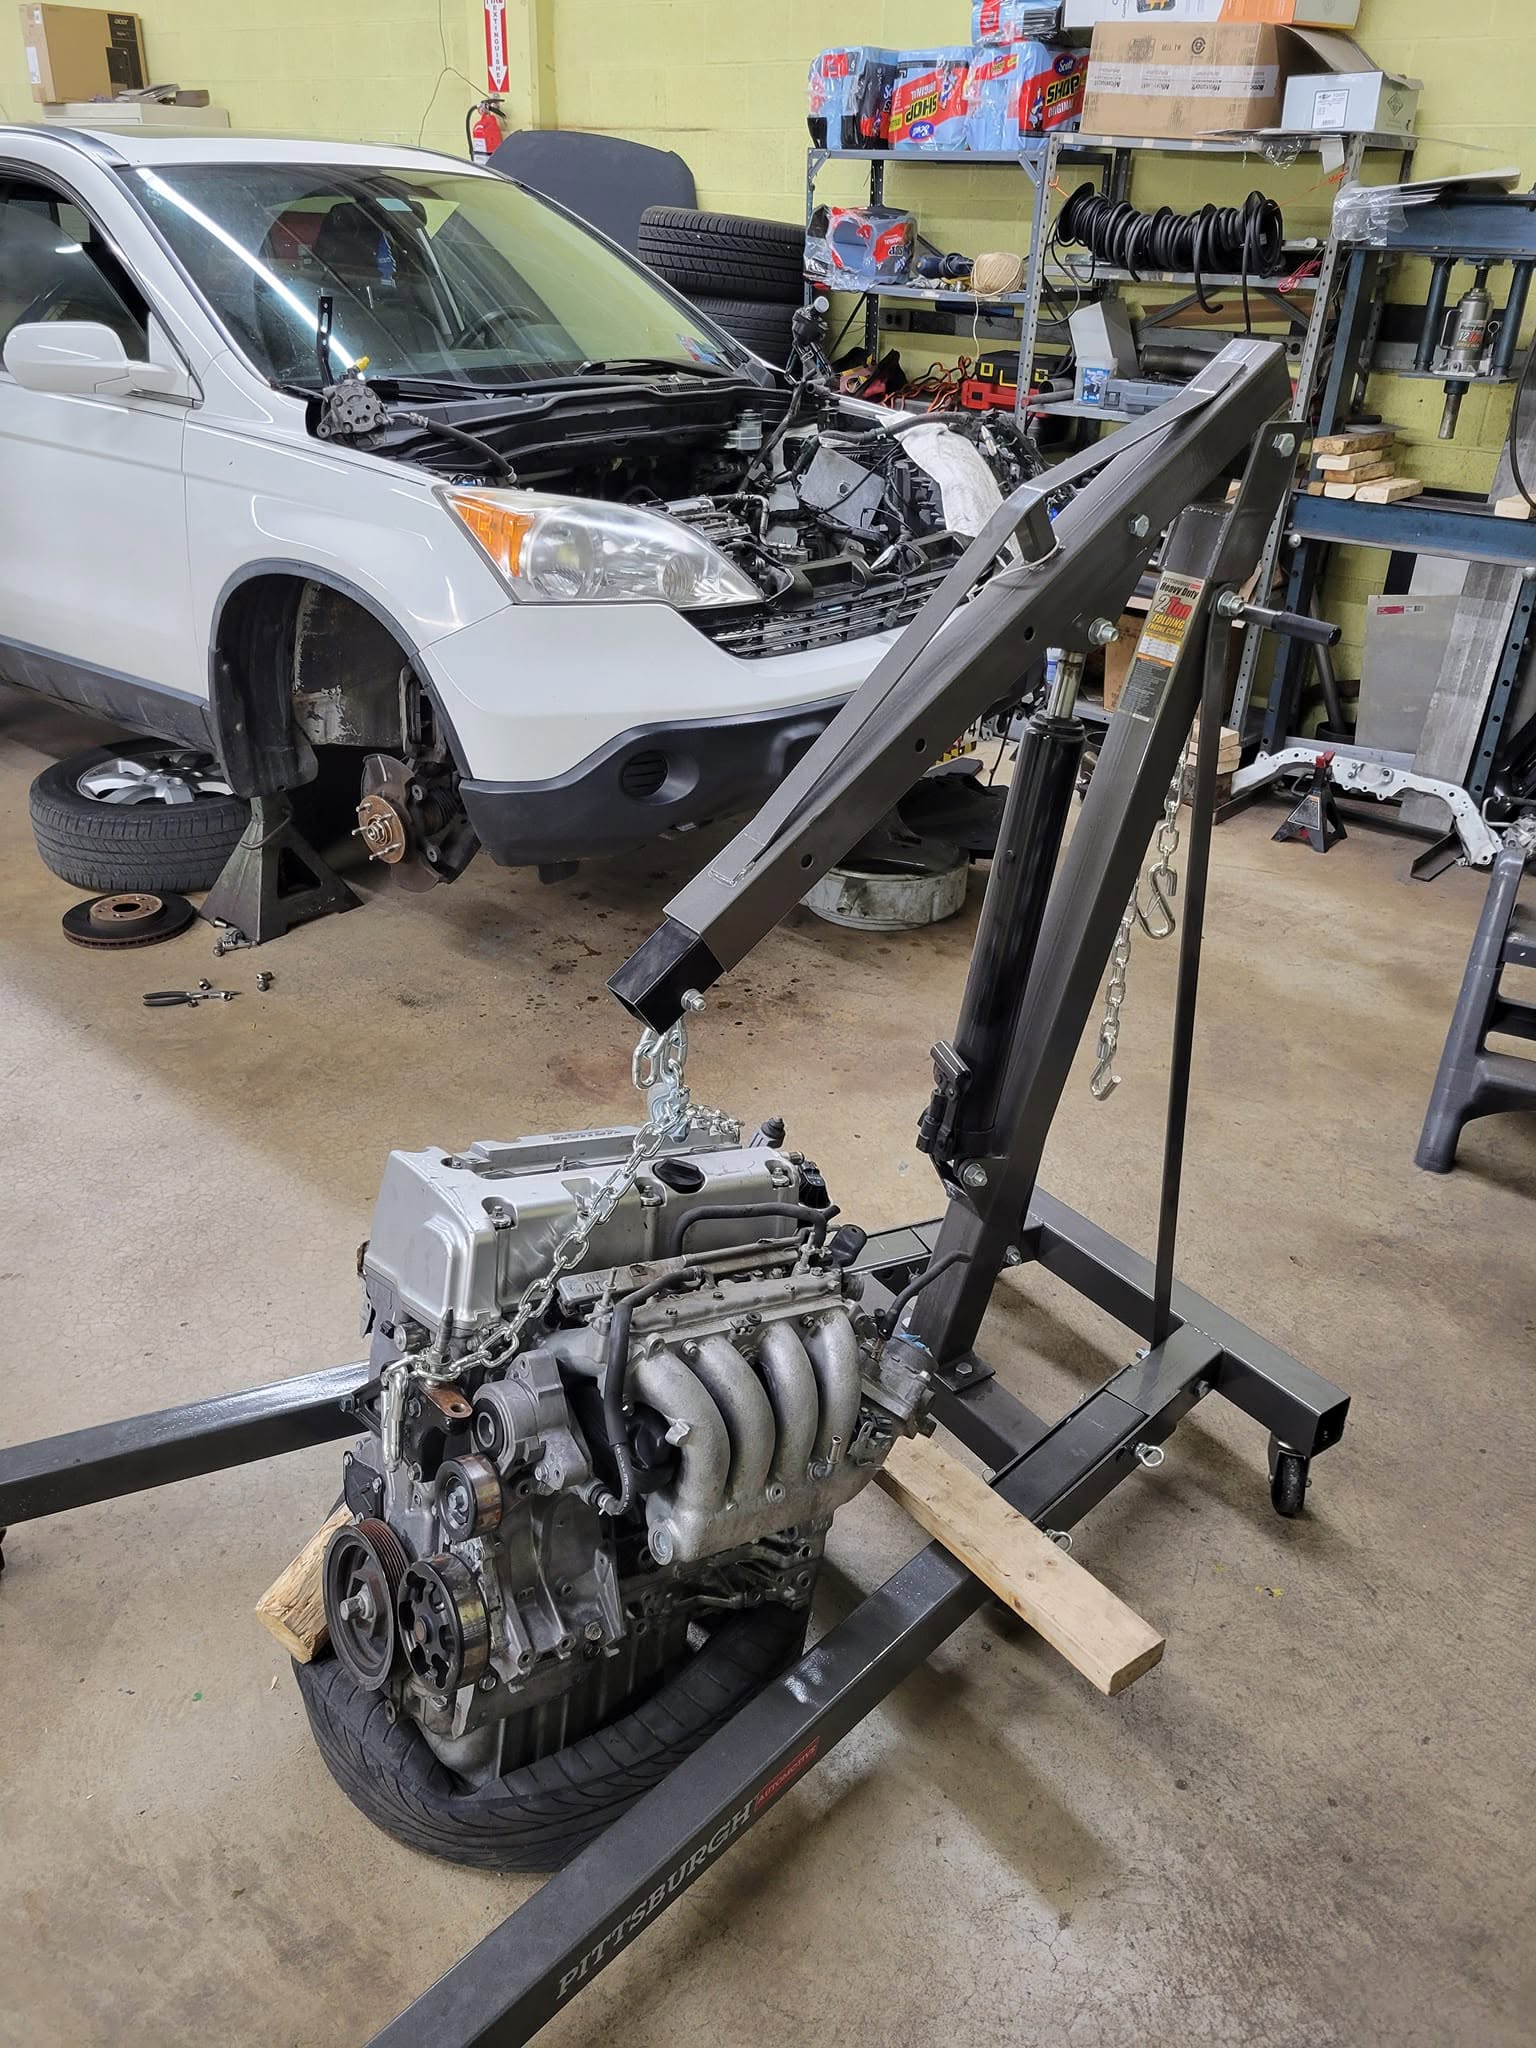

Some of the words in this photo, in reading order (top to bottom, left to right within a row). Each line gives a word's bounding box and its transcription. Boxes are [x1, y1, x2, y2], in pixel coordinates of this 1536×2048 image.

[492, 4, 502, 84] EXTINGUISHER
[1059, 58, 1074, 73] Scott
[1045, 74, 1081, 106] SHOP
[905, 92, 939, 125] SHOP
[1160, 582, 1182, 596] Heavy
[1181, 587, 1200, 600] Duty
[1152, 613, 1187, 630] FOLDING
[1154, 594, 1171, 614] 2
[1165, 596, 1192, 620] Ton
[556, 1799, 754, 2000] PITTSBURGH
[757, 1744, 818, 1805] AUTOMOTIVE
